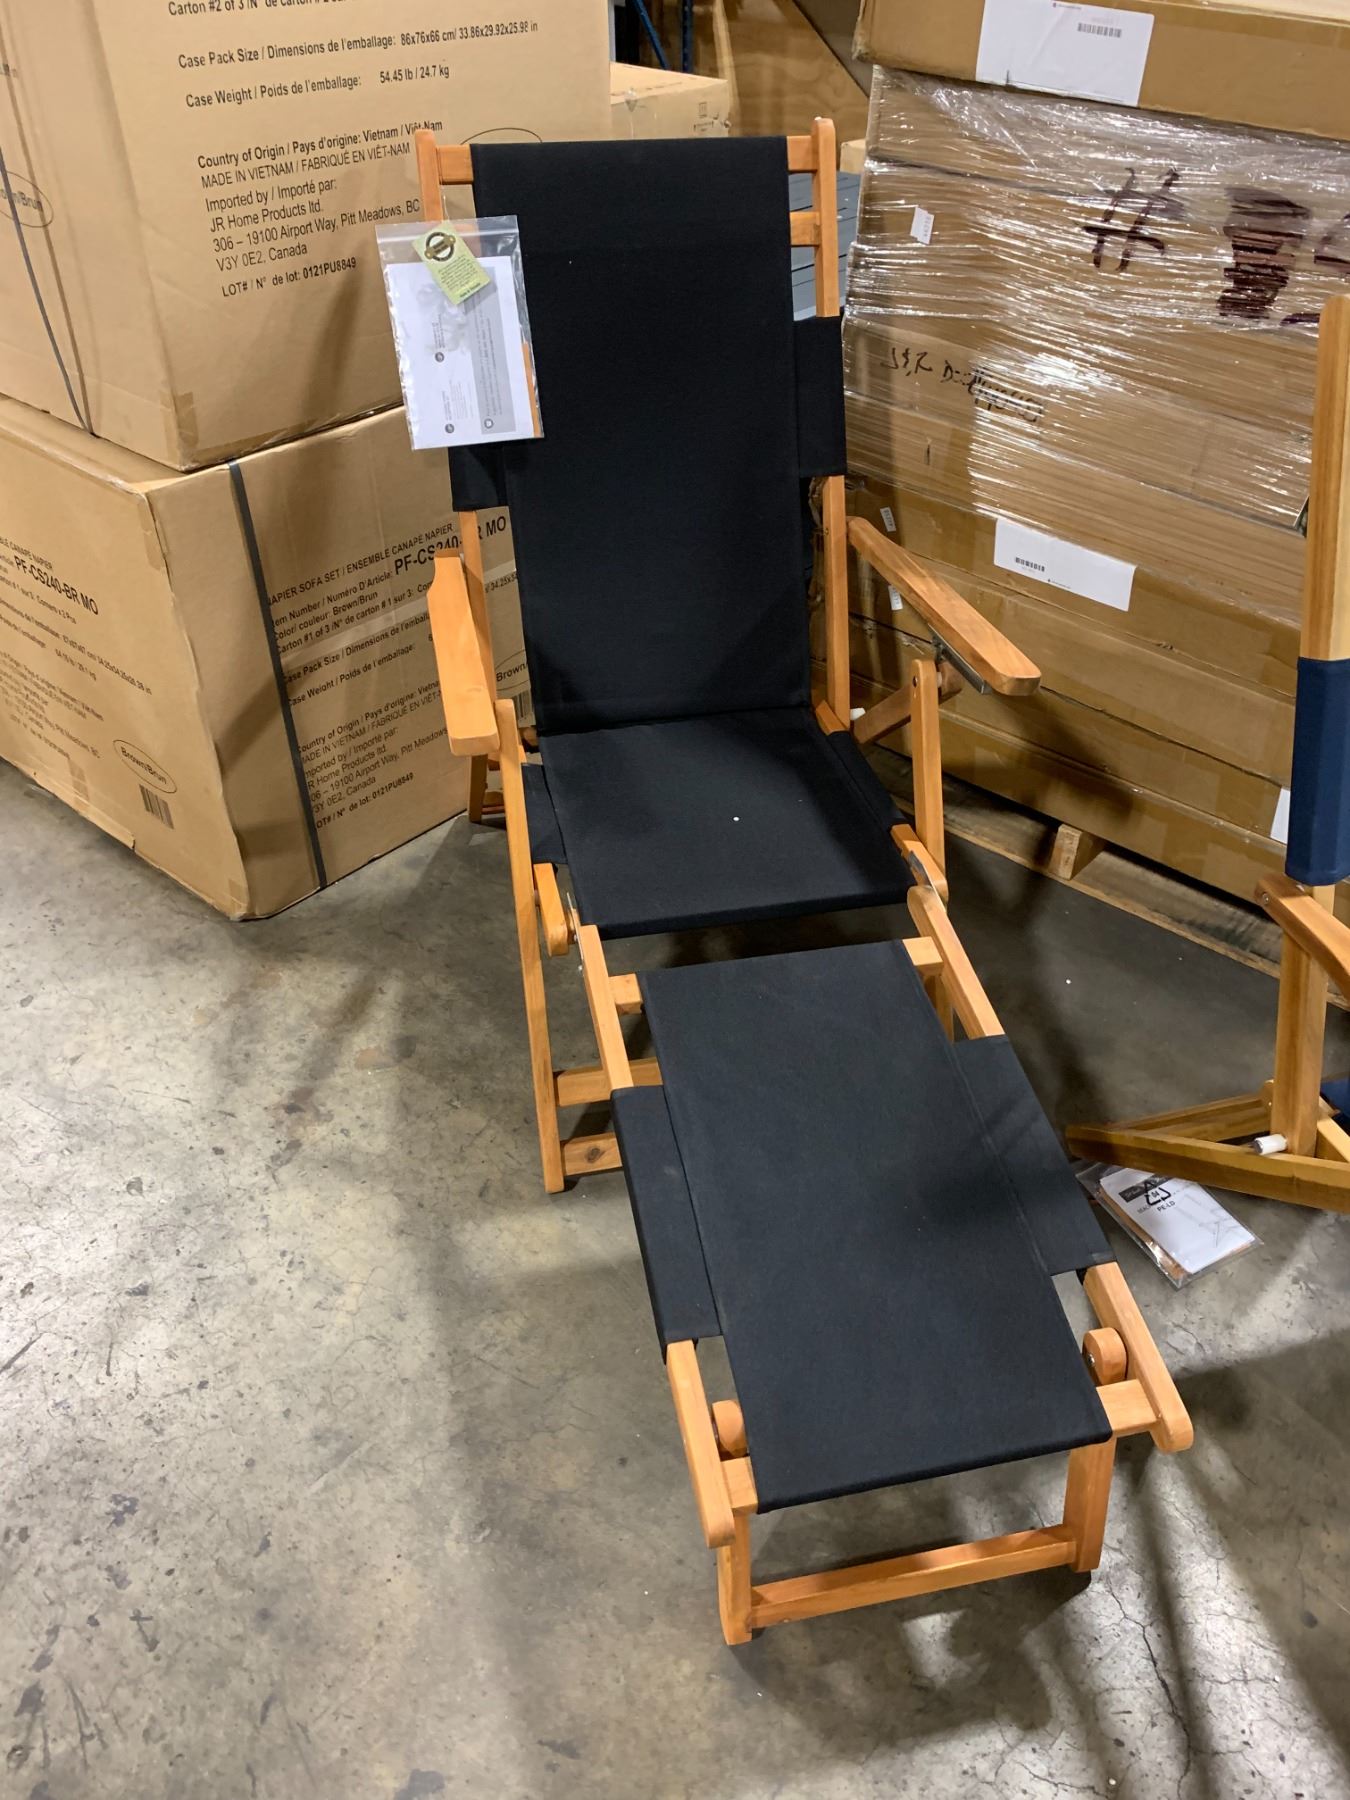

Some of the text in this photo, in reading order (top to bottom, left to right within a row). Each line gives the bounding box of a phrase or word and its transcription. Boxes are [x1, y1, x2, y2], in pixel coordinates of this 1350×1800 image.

[168, 1, 206, 16] Carton
[224, 0, 235, 11] of
[178, 54, 206, 69] Case
[208, 50, 235, 65] Pack
[237, 48, 259, 62] Size
[261, 46, 265, 60] /
[267, 43, 325, 59] Dimensions
[327, 39, 339, 52] de
[341, 35, 396, 51] l'emballage:
[400, 30, 440, 46] 86x76x66
[459, 20, 529, 39] 33.86x29.92x25.98
[530, 21, 538, 32] in
[185, 64, 450, 108] Case Weight / Poids de l'emballage: 54.45 lb / 24.7 kg
[197, 152, 239, 169] Country
[242, 148, 252, 161] of
[254, 144, 285, 161] Origin
[287, 143, 290, 155] /
[292, 140, 316, 154] Pays
[318, 135, 361, 151] d'origine:
[362, 128, 399, 142] Vietnam
[400, 126, 404, 137] /
[201, 172, 233, 189] MADE
[235, 170, 247, 183] IN
[248, 161, 294, 181] VIETNAM
[296, 161, 299, 173] /
[301, 152, 350, 172] FABRIQUÉ
[352, 150, 366, 163] EN
[205, 179, 337, 212] Imported by / Importé par:
[210, 216, 226, 233] JR
[227, 214, 259, 229] Home
[262, 203, 307, 223] Products
[213, 198, 421, 253] 306 19100 Airport Way, Pitt Meadows, BC
[216, 255, 239, 272] V3Y
[268, 243, 308, 261] Canada
[222, 281, 248, 297] LOT#
[272, 274, 284, 286] de
[285, 269, 301, 284] lot:
[303, 256, 357, 279] 0121PU8849
[14, 555, 80, 605] PF-CS240-BR
[80, 592, 99, 616] MO
[269, 586, 298, 606] APIER
[299, 577, 323, 593] SOFA
[324, 568, 341, 583] SET
[346, 548, 391, 574] ENSEMBLE
[424, 523, 453, 540] NAPIER
[289, 600, 320, 619] Number
[326, 585, 358, 604] Numéro
[486, 516, 507, 537] MO
[276, 591, 378, 640] olor/ couleur: Brown/Brun
[304, 632, 313, 642] #1
[315, 628, 324, 639] of
[324, 623, 330, 634] 3
[345, 614, 355, 625] de
[356, 603, 380, 619] carton
[381, 600, 386, 609] #
[393, 593, 406, 604] sur
[303, 660, 322, 676] Pack
[324, 654, 340, 666] Size
[345, 632, 389, 656] Dimensions
[390, 625, 399, 636] de
[307, 680, 334, 698] Weight
[339, 668, 361, 683] Poids
[362, 661, 373, 673] de
[322, 745, 331, 754] IN
[332, 727, 366, 749] VIETNAM
[409, 701, 420, 711] EN
[327, 729, 335, 740] of
[337, 719, 360, 735] Origin
[364, 708, 383, 721] Pays
[120, 745, 167, 785] Brown/Brun
[305, 757, 336, 778] mported
[311, 790, 321, 802] 06
[330, 772, 354, 791] 19100
[355, 760, 380, 778] Airport
[400, 743, 413, 756] Pitt
[316, 769, 340, 786] Home
[341, 751, 376, 773] Products
[313, 800, 324, 814] 3Y
[346, 776, 376, 796] Canada
[316, 814, 331, 829] OT#
[348, 802, 358, 812] de
[372, 771, 414, 799] 0121PU8849
[1156, 1200, 1176, 1212] PE-LD
